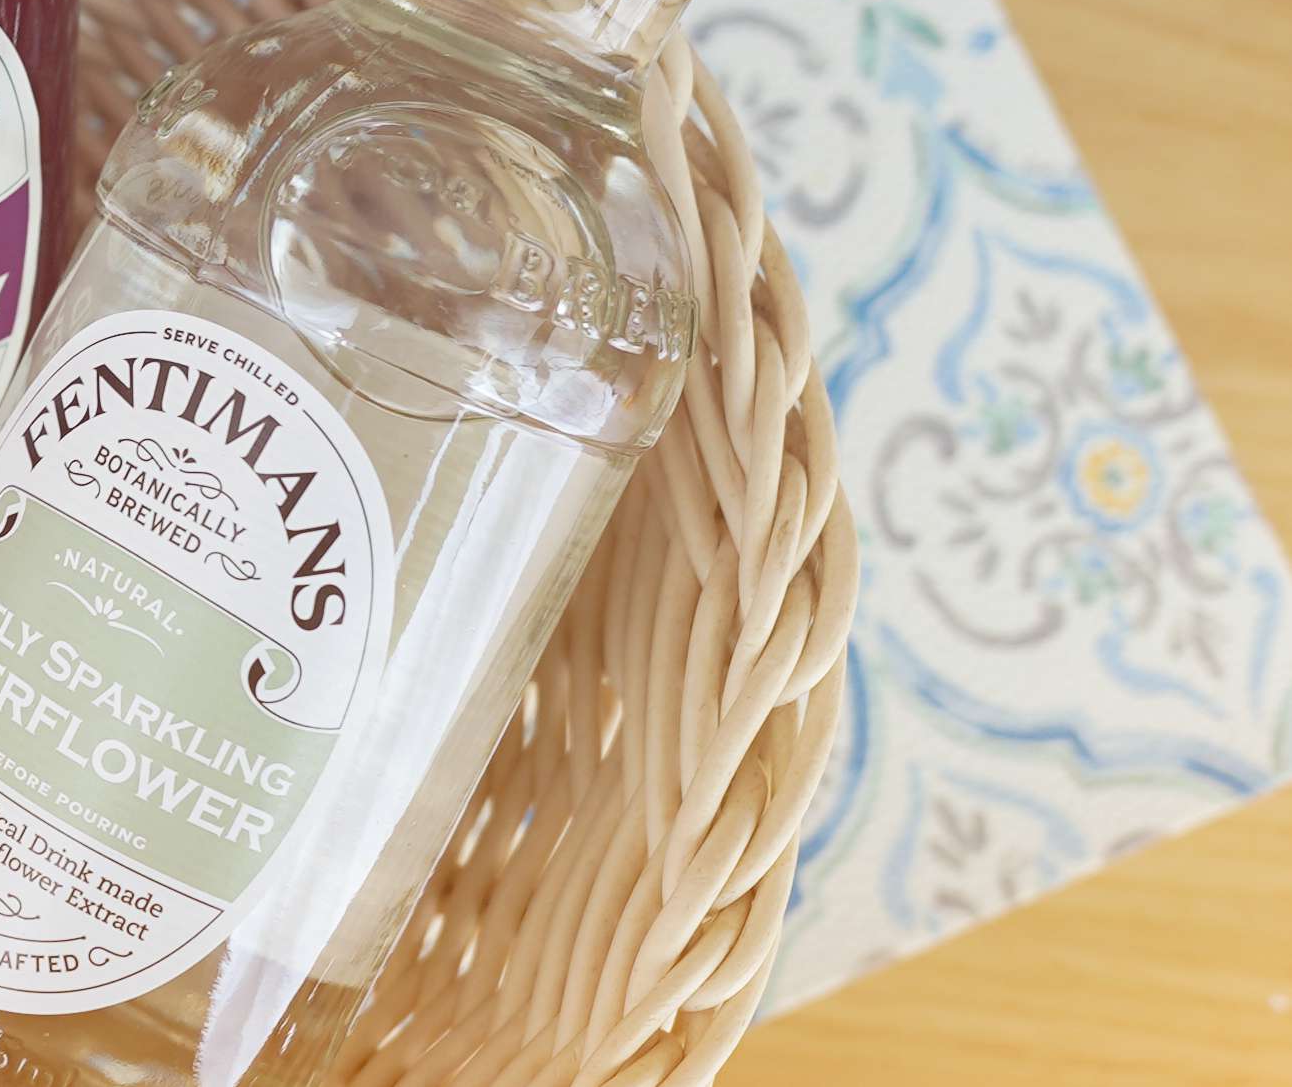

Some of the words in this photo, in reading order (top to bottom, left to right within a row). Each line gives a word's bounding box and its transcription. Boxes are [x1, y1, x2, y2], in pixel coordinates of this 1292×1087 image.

[163, 327, 219, 354] SERVE
[223, 349, 300, 407] CHILLED
[21, 357, 346, 631] FENTIMANS
[94, 445, 247, 544] BOTANICALLY
[106, 488, 202, 554] BREWED
[41, 640, 295, 797] SPARKLING
[55, 791, 148, 850] POURING
[29, 834, 93, 882] Drink
[98, 877, 164, 918] made
[65, 889, 151, 941] Extract
